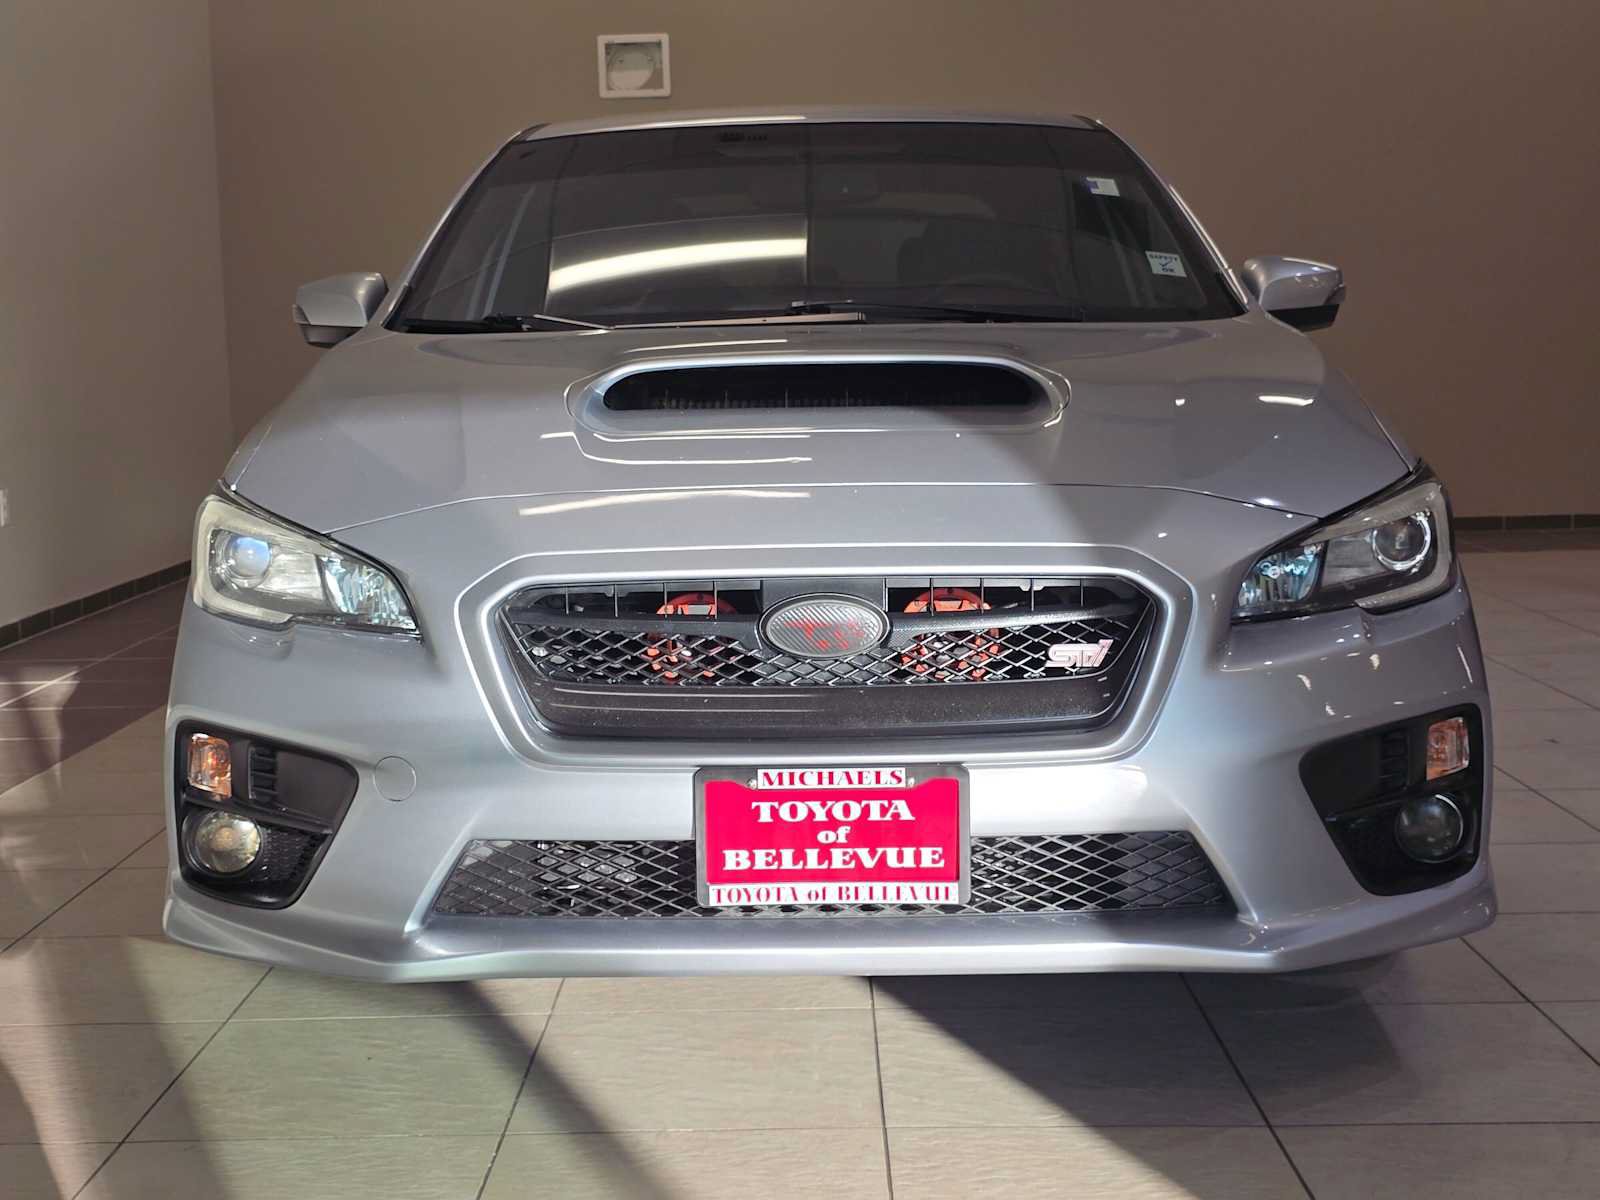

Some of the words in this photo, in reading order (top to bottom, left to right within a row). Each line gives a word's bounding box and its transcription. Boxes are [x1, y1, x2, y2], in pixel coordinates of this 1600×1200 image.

[761, 770, 903, 787] MICHAELS
[751, 799, 916, 823] TOYOTA
[816, 826, 851, 844] of
[722, 847, 945, 871] BELLEVUE
[712, 886, 799, 905] TOYOTA
[807, 886, 828, 902] of
